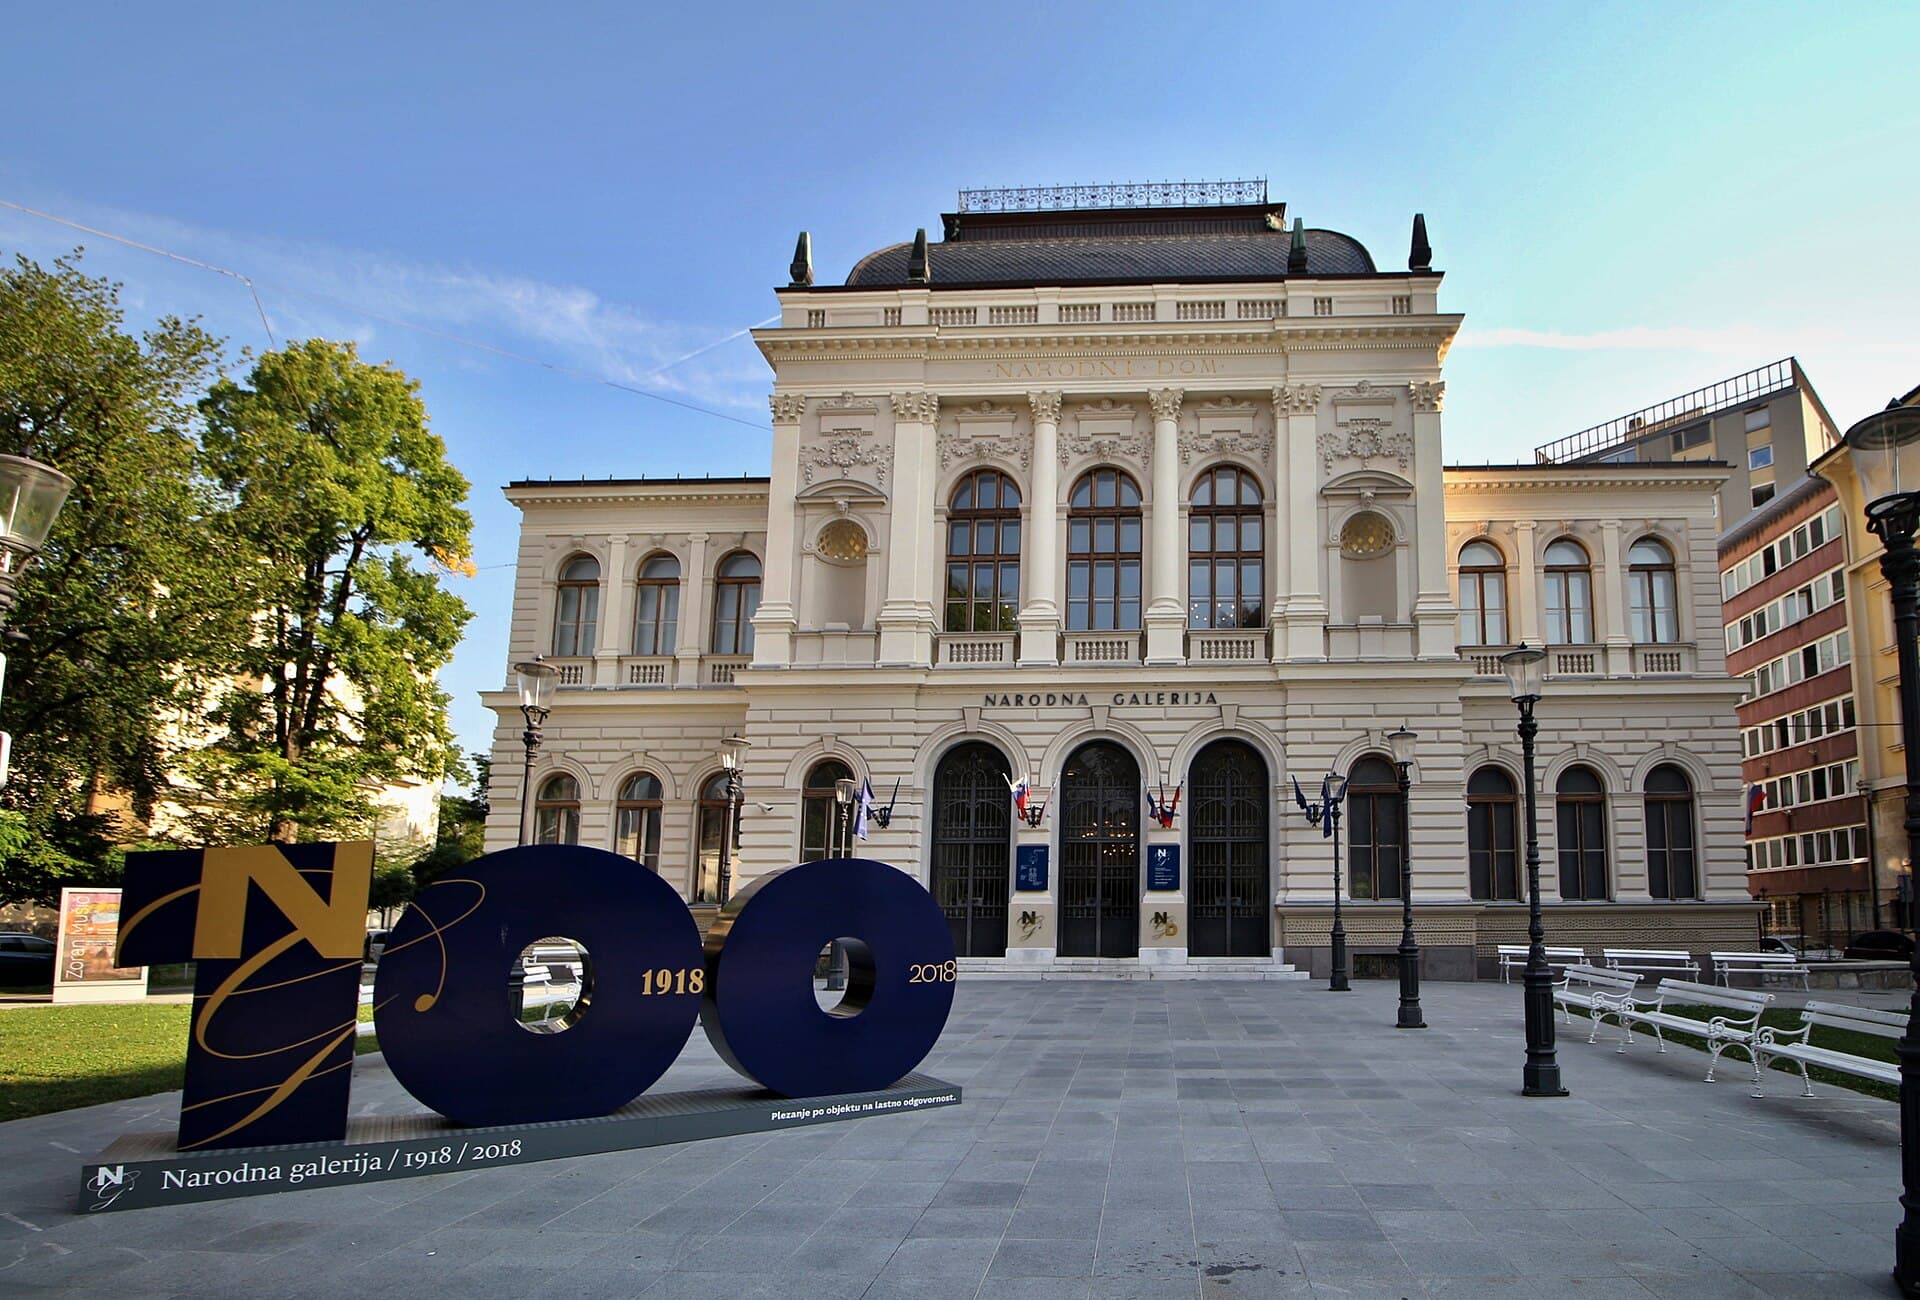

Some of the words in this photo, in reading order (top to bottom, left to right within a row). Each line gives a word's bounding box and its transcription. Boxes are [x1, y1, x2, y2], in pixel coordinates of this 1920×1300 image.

[995, 359, 1133, 378] NARODNI
[984, 693, 1090, 708] NARODNA
[1112, 692, 1218, 706] GALERIJA
[65, 939, 86, 979] Zoran
[909, 960, 957, 983] 2018
[641, 968, 705, 995] 1918
[771, 1108, 811, 1121] Plezanje
[812, 1107, 825, 1119] po
[826, 1104, 861, 1117] objektu
[862, 1103, 873, 1111] na
[874, 1100, 902, 1109] lastno
[903, 1093, 957, 1108] odgovornost.
[160, 1162, 282, 1190] Narodna
[288, 1152, 383, 1184] galerija
[403, 1146, 452, 1170] 1918
[472, 1139, 522, 1161] 2018
